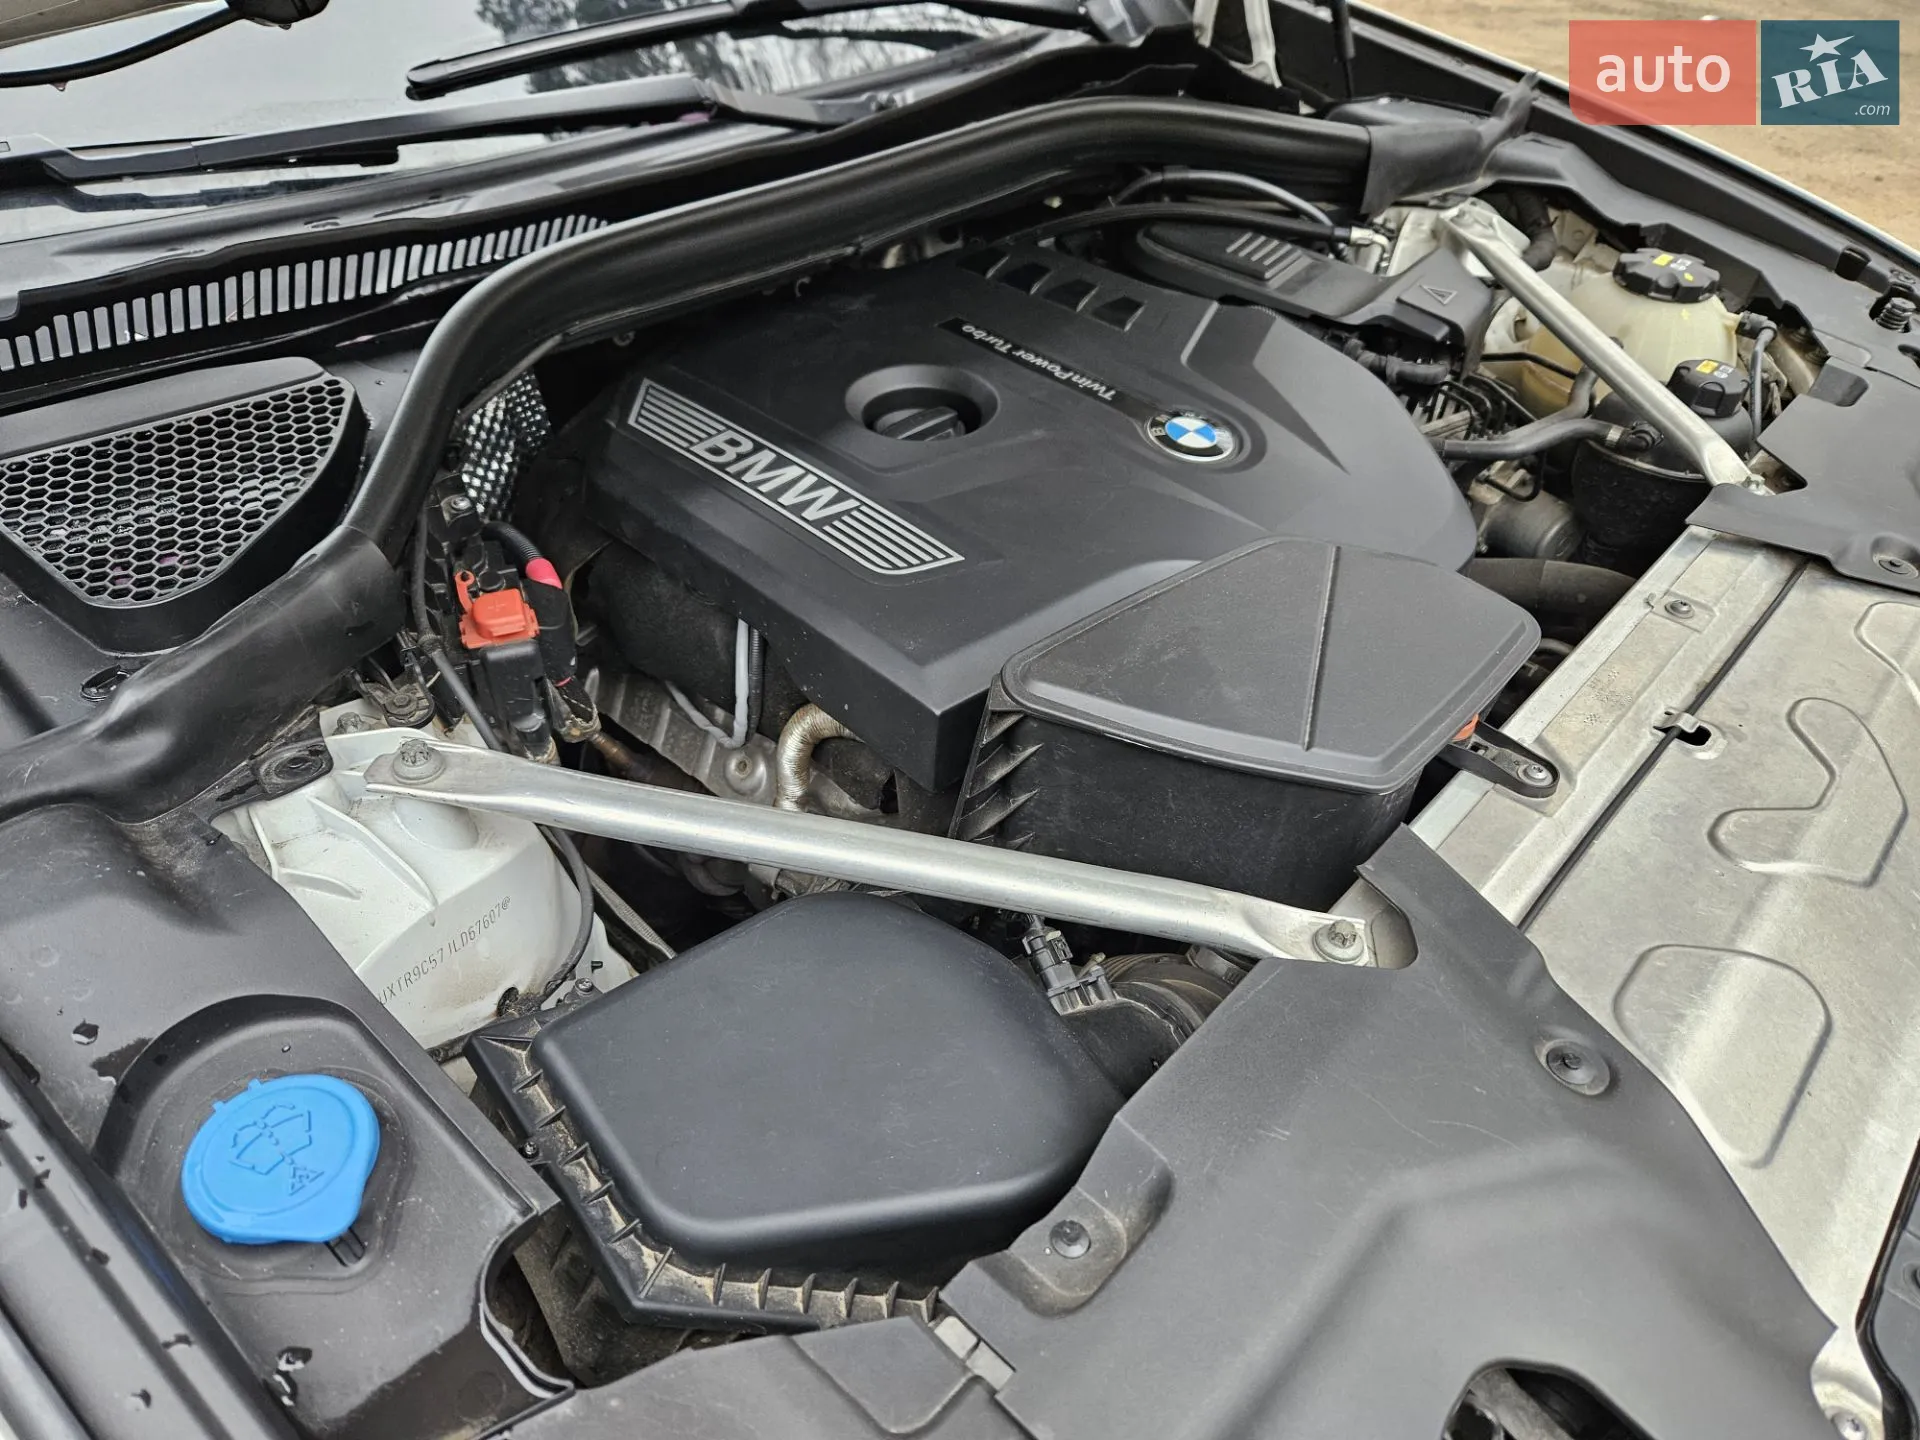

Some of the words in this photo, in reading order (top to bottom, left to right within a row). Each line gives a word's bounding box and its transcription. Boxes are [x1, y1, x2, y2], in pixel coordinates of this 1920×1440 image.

[961, 324, 1012, 354] Turbo
[1012, 350, 1117, 401] TwinPower
[690, 429, 861, 521] BMW
